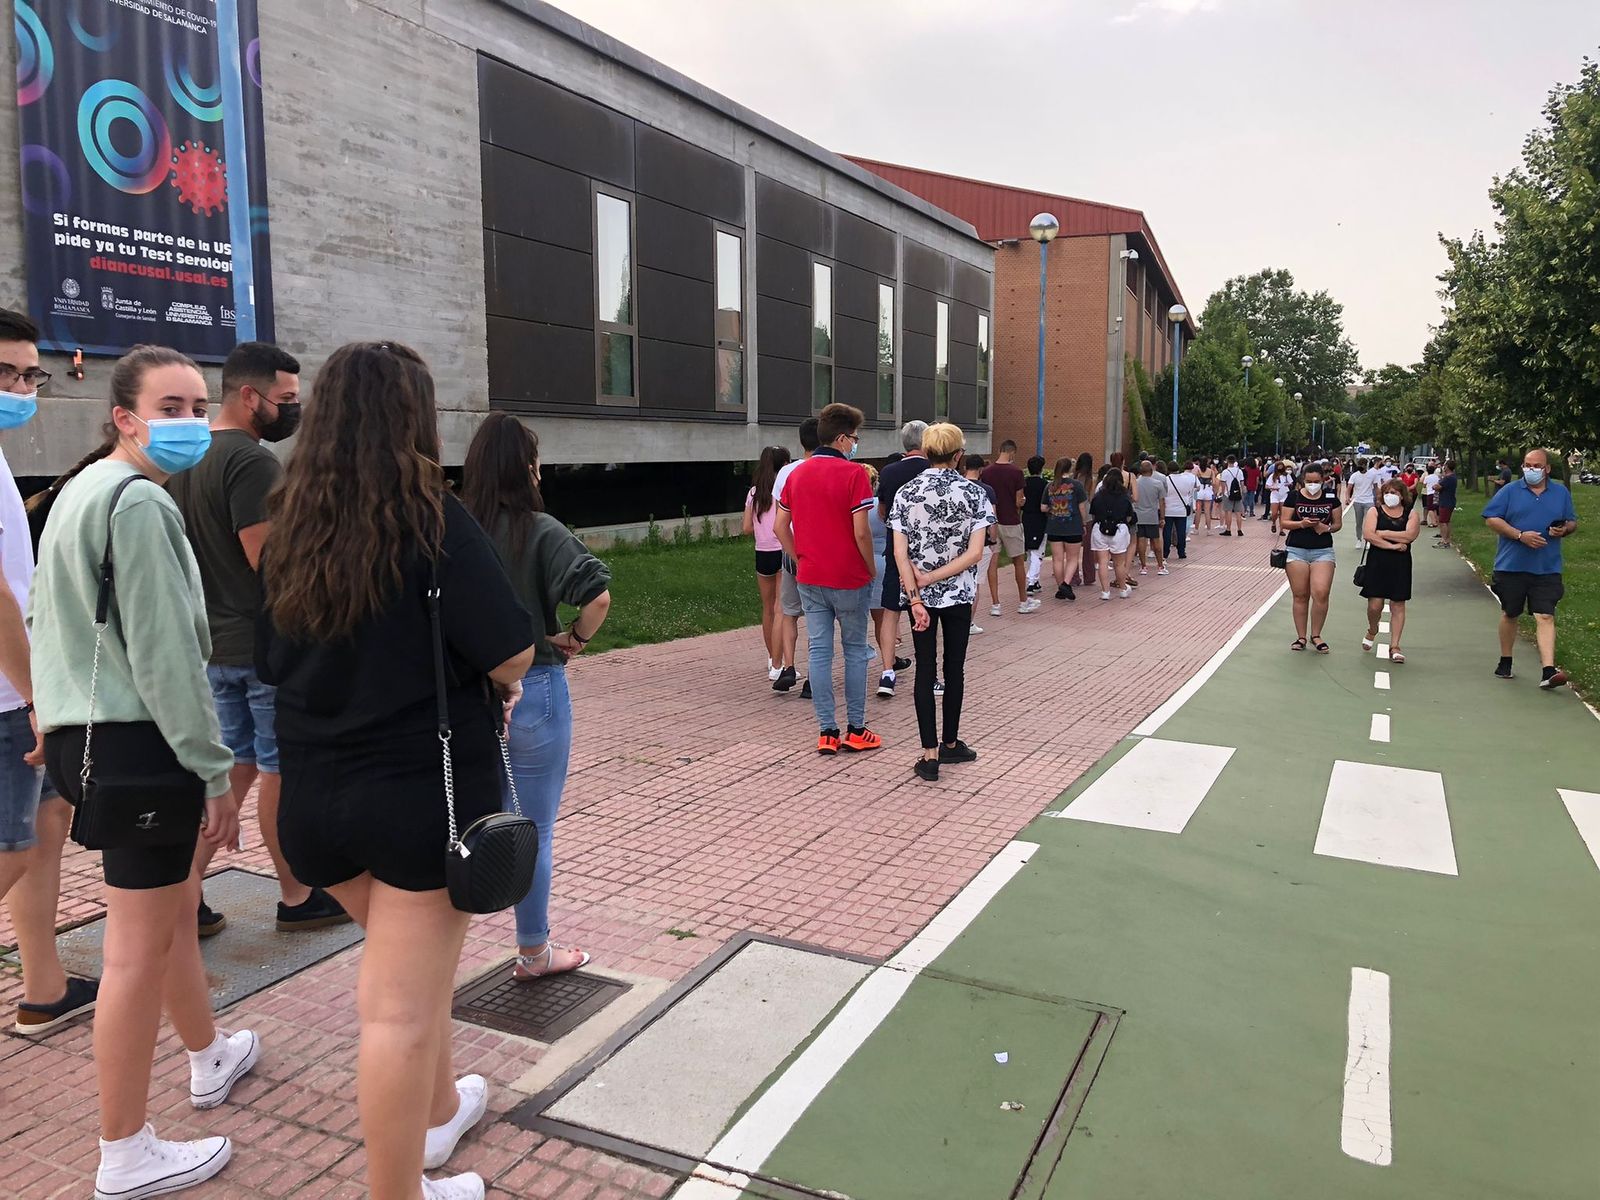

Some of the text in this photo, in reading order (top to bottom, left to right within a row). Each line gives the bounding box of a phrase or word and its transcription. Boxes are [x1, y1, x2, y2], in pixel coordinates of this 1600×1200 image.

[141, 0, 217, 28] MIENTO DE COVID-19
[152, 8, 163, 19] DE
[163, 13, 208, 34] SALAMANCA
[53, 212, 233, 256] Si formas parte de la US
[54, 232, 233, 273] pide ya tu Test Serológi
[89, 255, 229, 288] diancusal.usal.es
[115, 298, 133, 306] Junta
[115, 304, 137, 313] Castilla
[1298, 505, 1330, 513] GUESS
